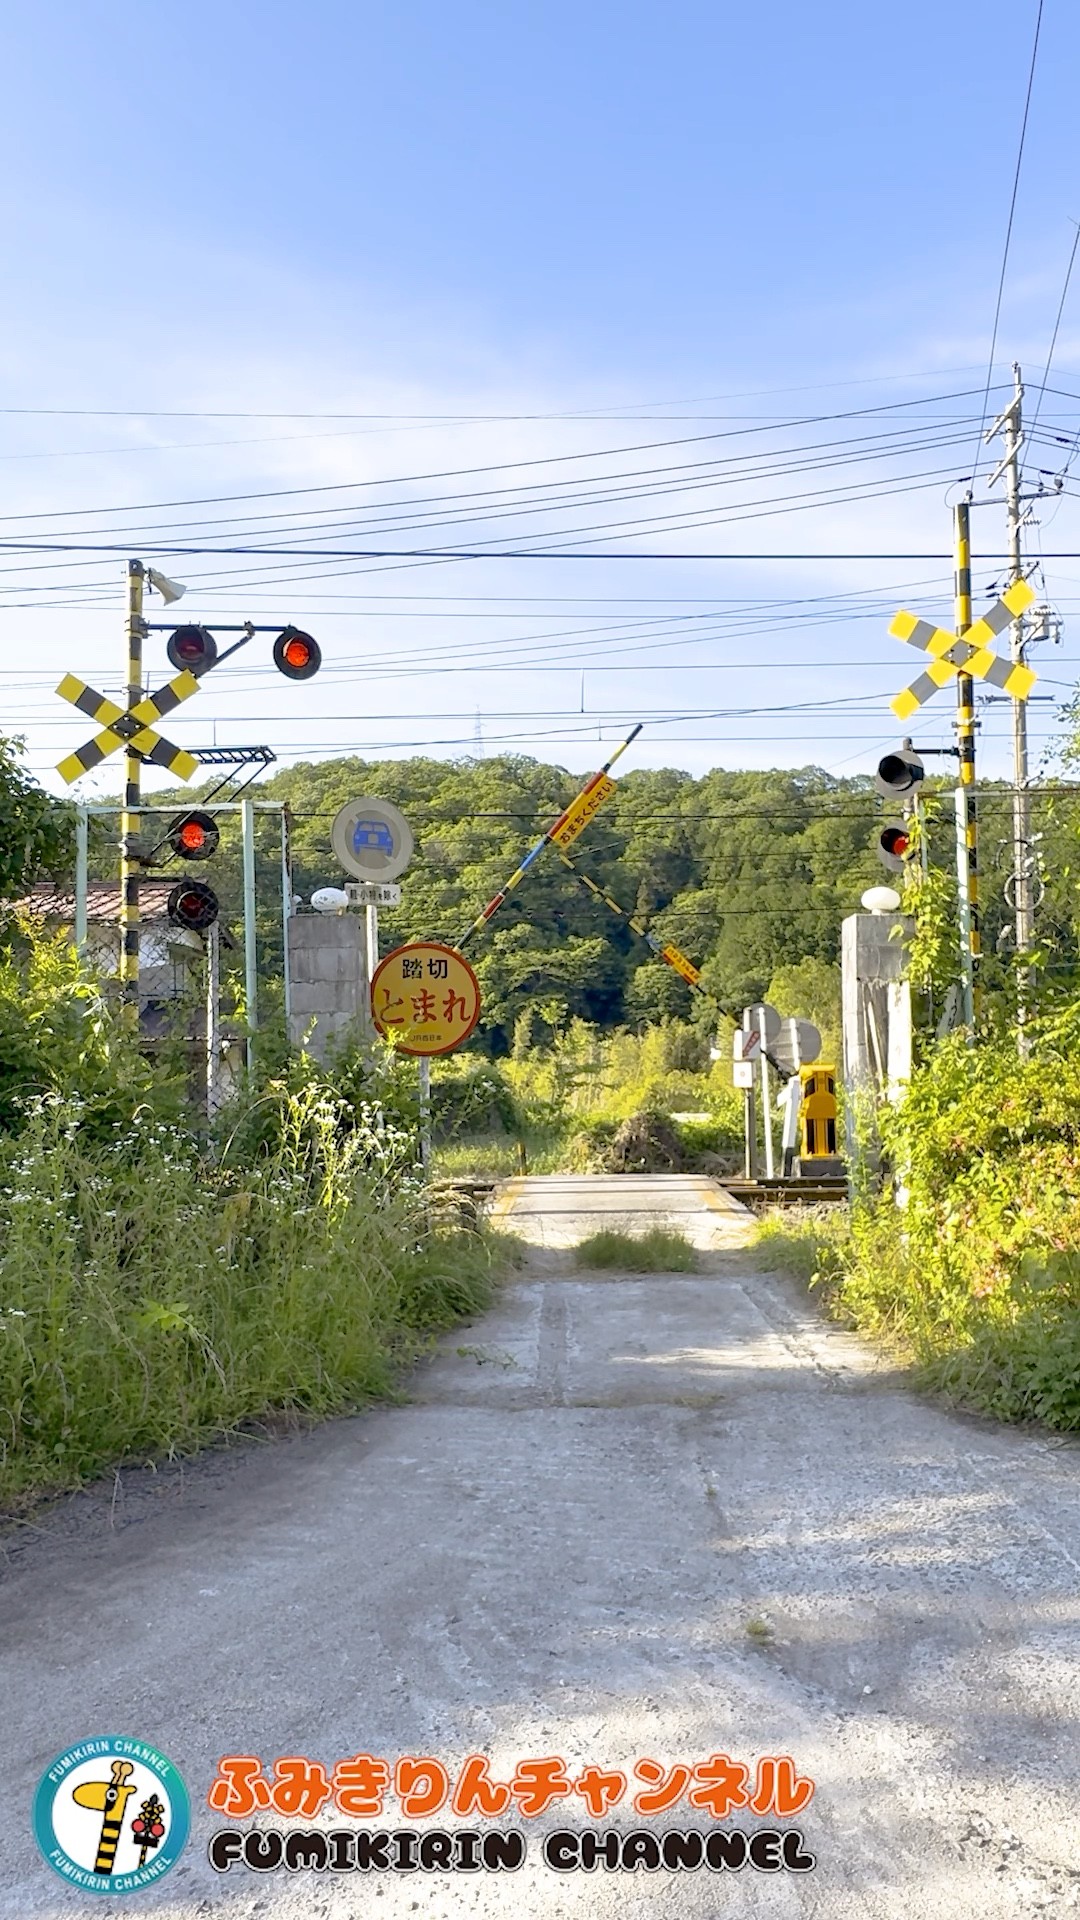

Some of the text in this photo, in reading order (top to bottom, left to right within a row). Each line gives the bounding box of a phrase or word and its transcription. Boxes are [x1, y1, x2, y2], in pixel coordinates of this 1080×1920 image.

[560, 782, 613, 844] おまちください
[402, 958, 448, 979] 踏切
[380, 988, 471, 1023] とまれ
[412, 1034, 442, 1042] JR西日本
